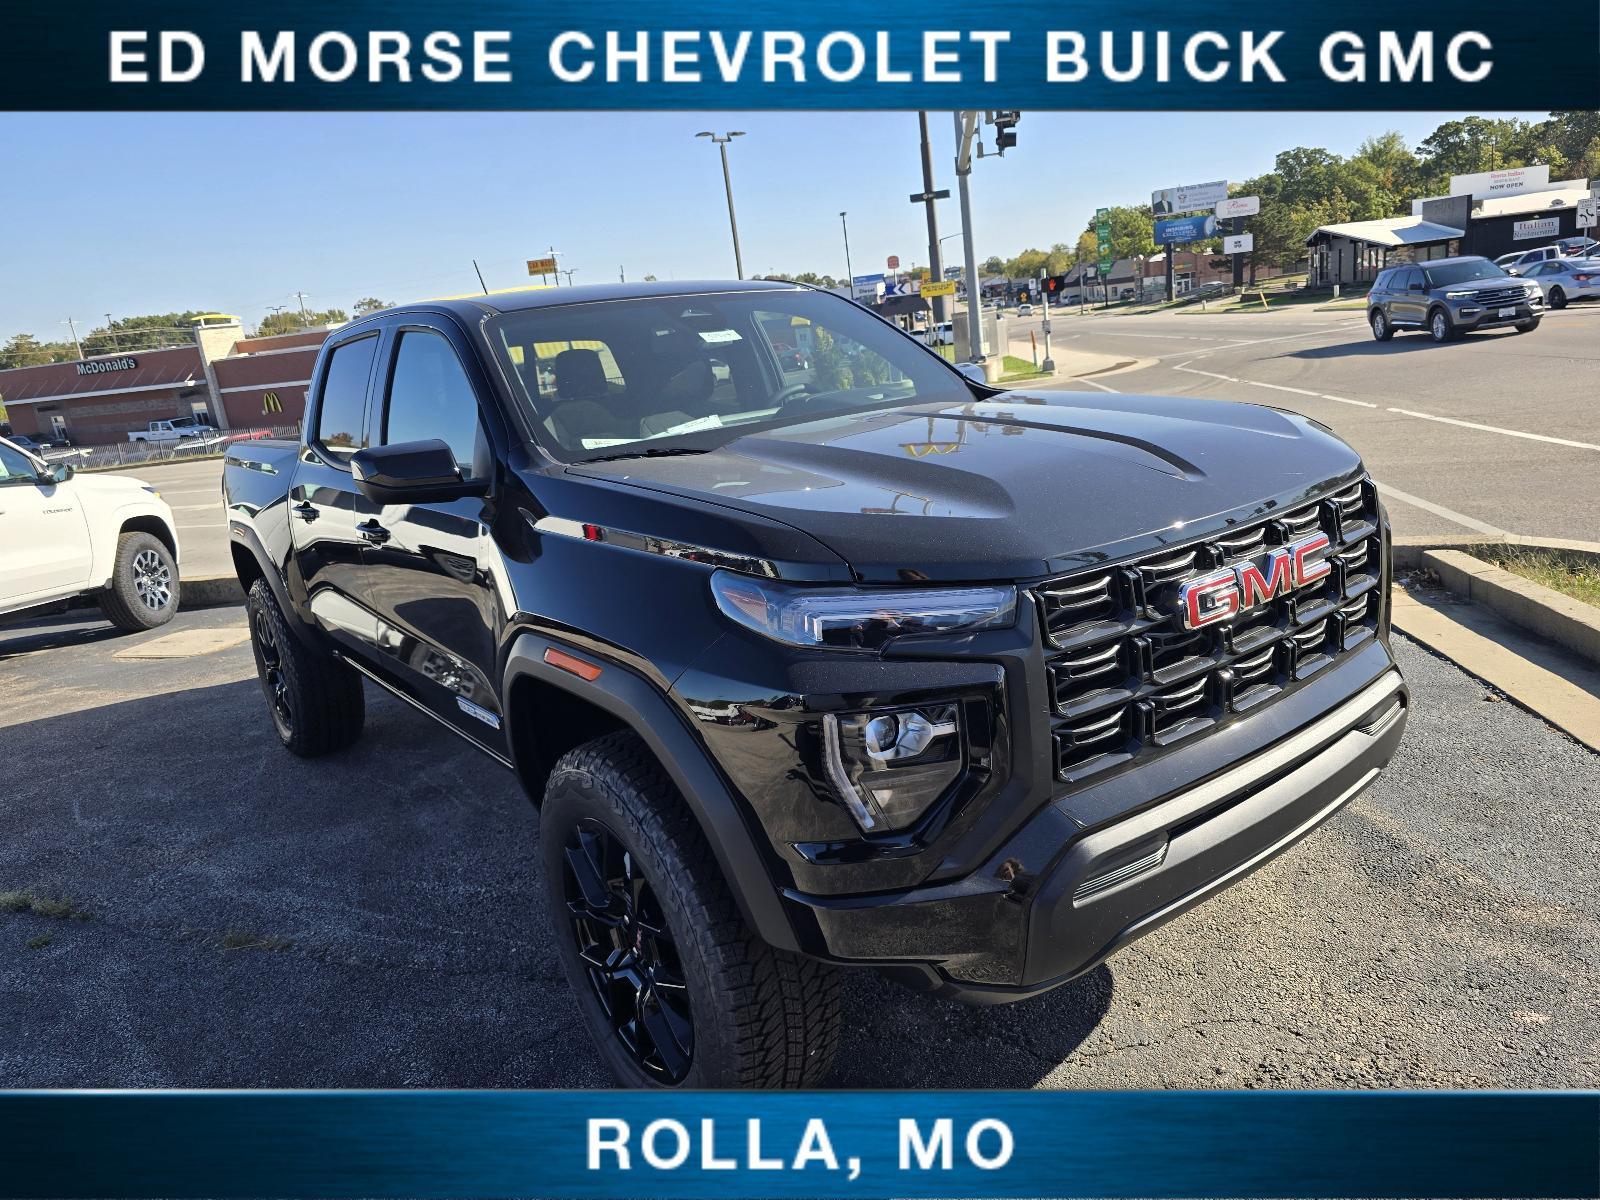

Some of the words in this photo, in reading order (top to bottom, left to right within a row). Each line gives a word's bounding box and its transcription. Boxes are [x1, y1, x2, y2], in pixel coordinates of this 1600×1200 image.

[1489, 183, 1505, 191] NOW
[1519, 220, 1555, 230] Italian
[1514, 228, 1557, 238] Restaurant
[76, 357, 136, 375] McDonald's
[1178, 531, 1333, 630] GMC
